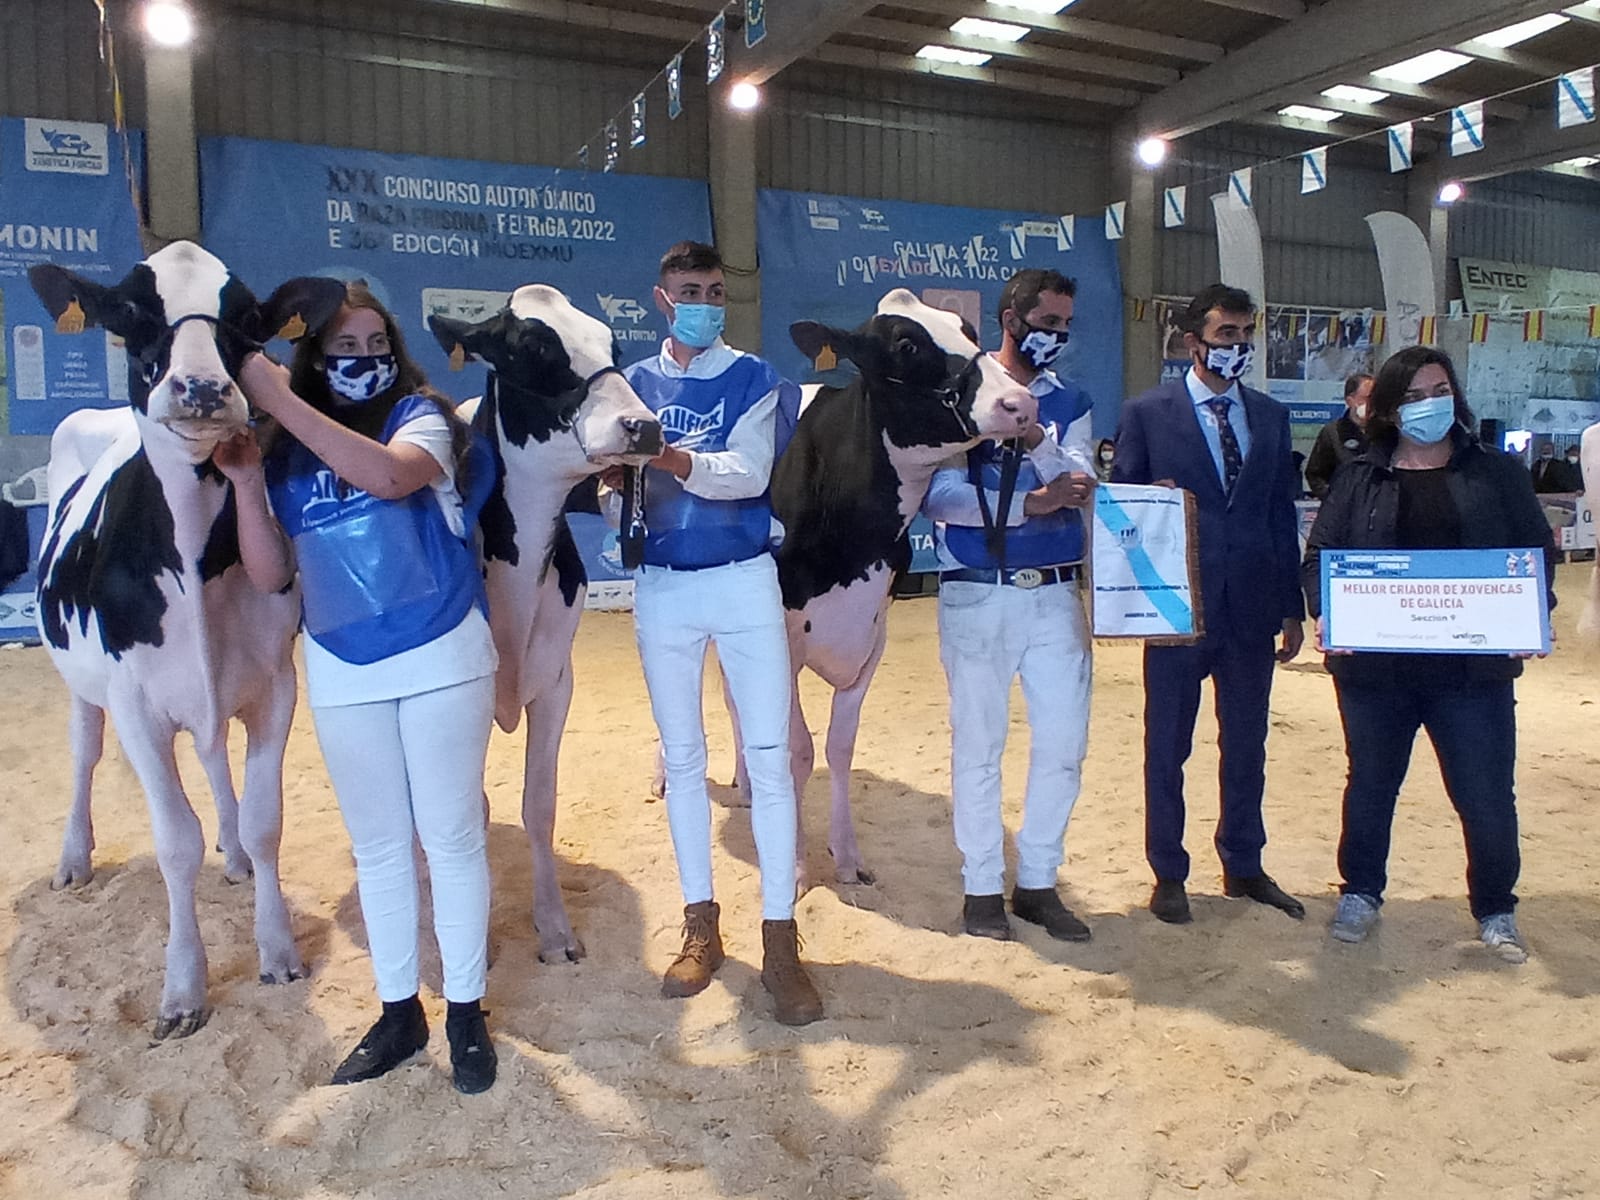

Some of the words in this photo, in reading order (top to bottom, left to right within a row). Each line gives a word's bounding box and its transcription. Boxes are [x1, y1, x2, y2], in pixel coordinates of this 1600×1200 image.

[384, 176, 480, 205] CONCURSO
[327, 199, 354, 223] DA
[571, 218, 616, 241] 2022
[329, 228, 342, 248] E
[392, 233, 480, 257] EDICIÓN
[961, 246, 998, 262] 222
[1466, 265, 1527, 289] ENTEC
[1343, 583, 1387, 594] MELLOR
[1389, 584, 1440, 595] CRIADOR
[1443, 584, 1458, 595] DE
[1460, 583, 1523, 595] XOVENCAS
[1400, 598, 1415, 609] DE
[1417, 598, 1464, 609] GALICIA
